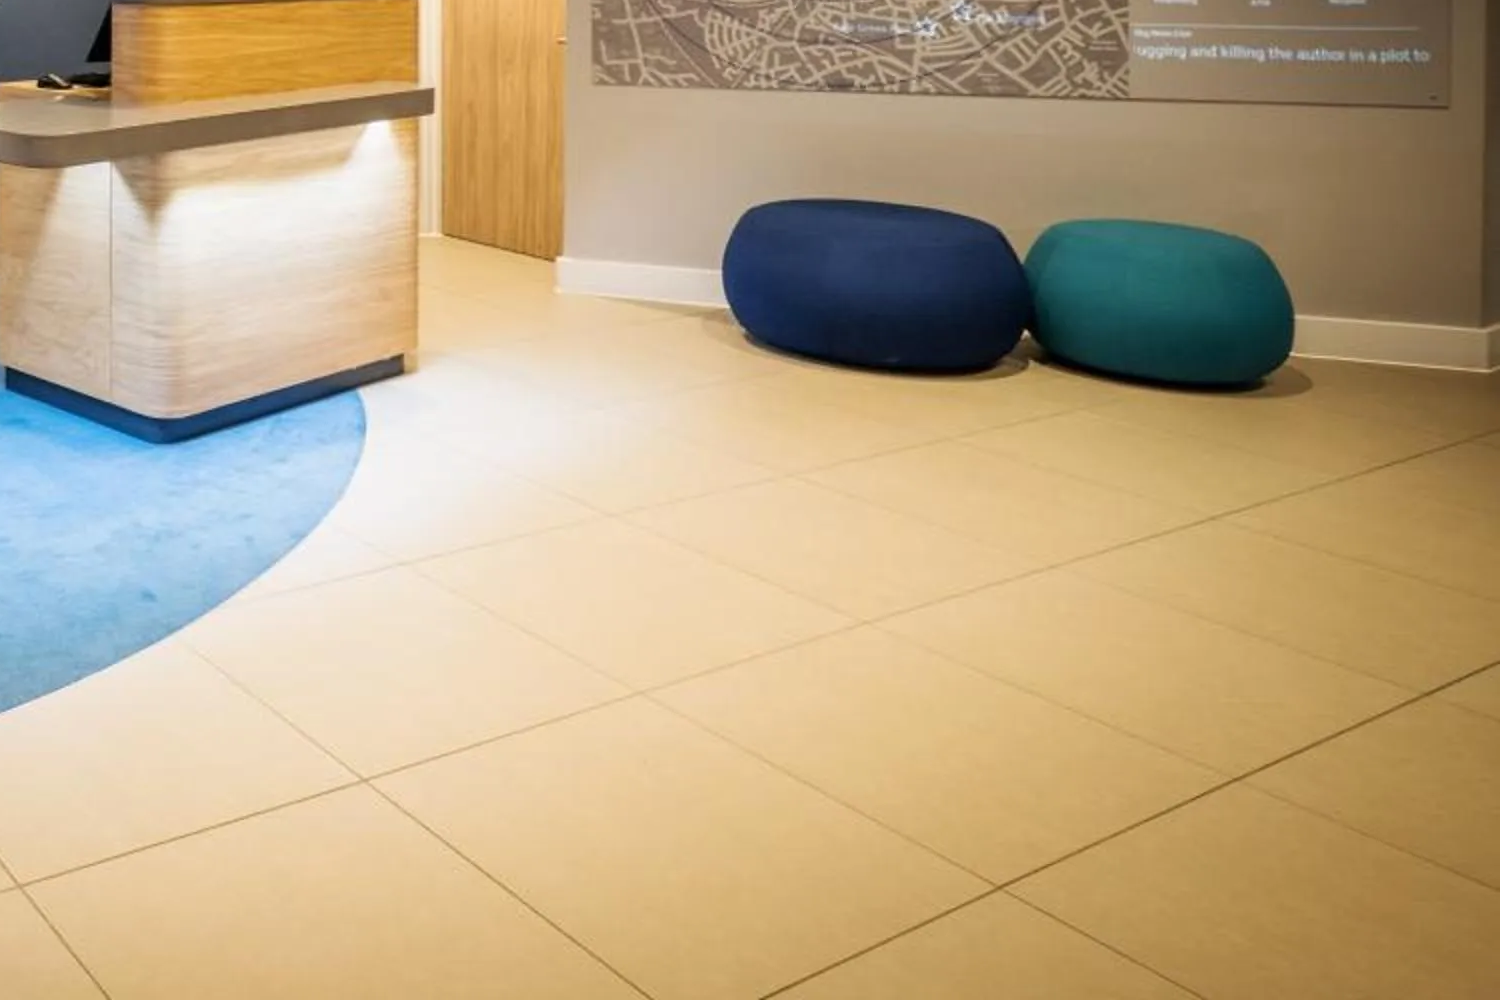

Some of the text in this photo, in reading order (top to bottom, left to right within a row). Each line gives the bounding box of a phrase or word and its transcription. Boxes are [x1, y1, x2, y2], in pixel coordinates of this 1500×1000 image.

[1133, 44, 1431, 64] ugging and killing the author in a plot to
